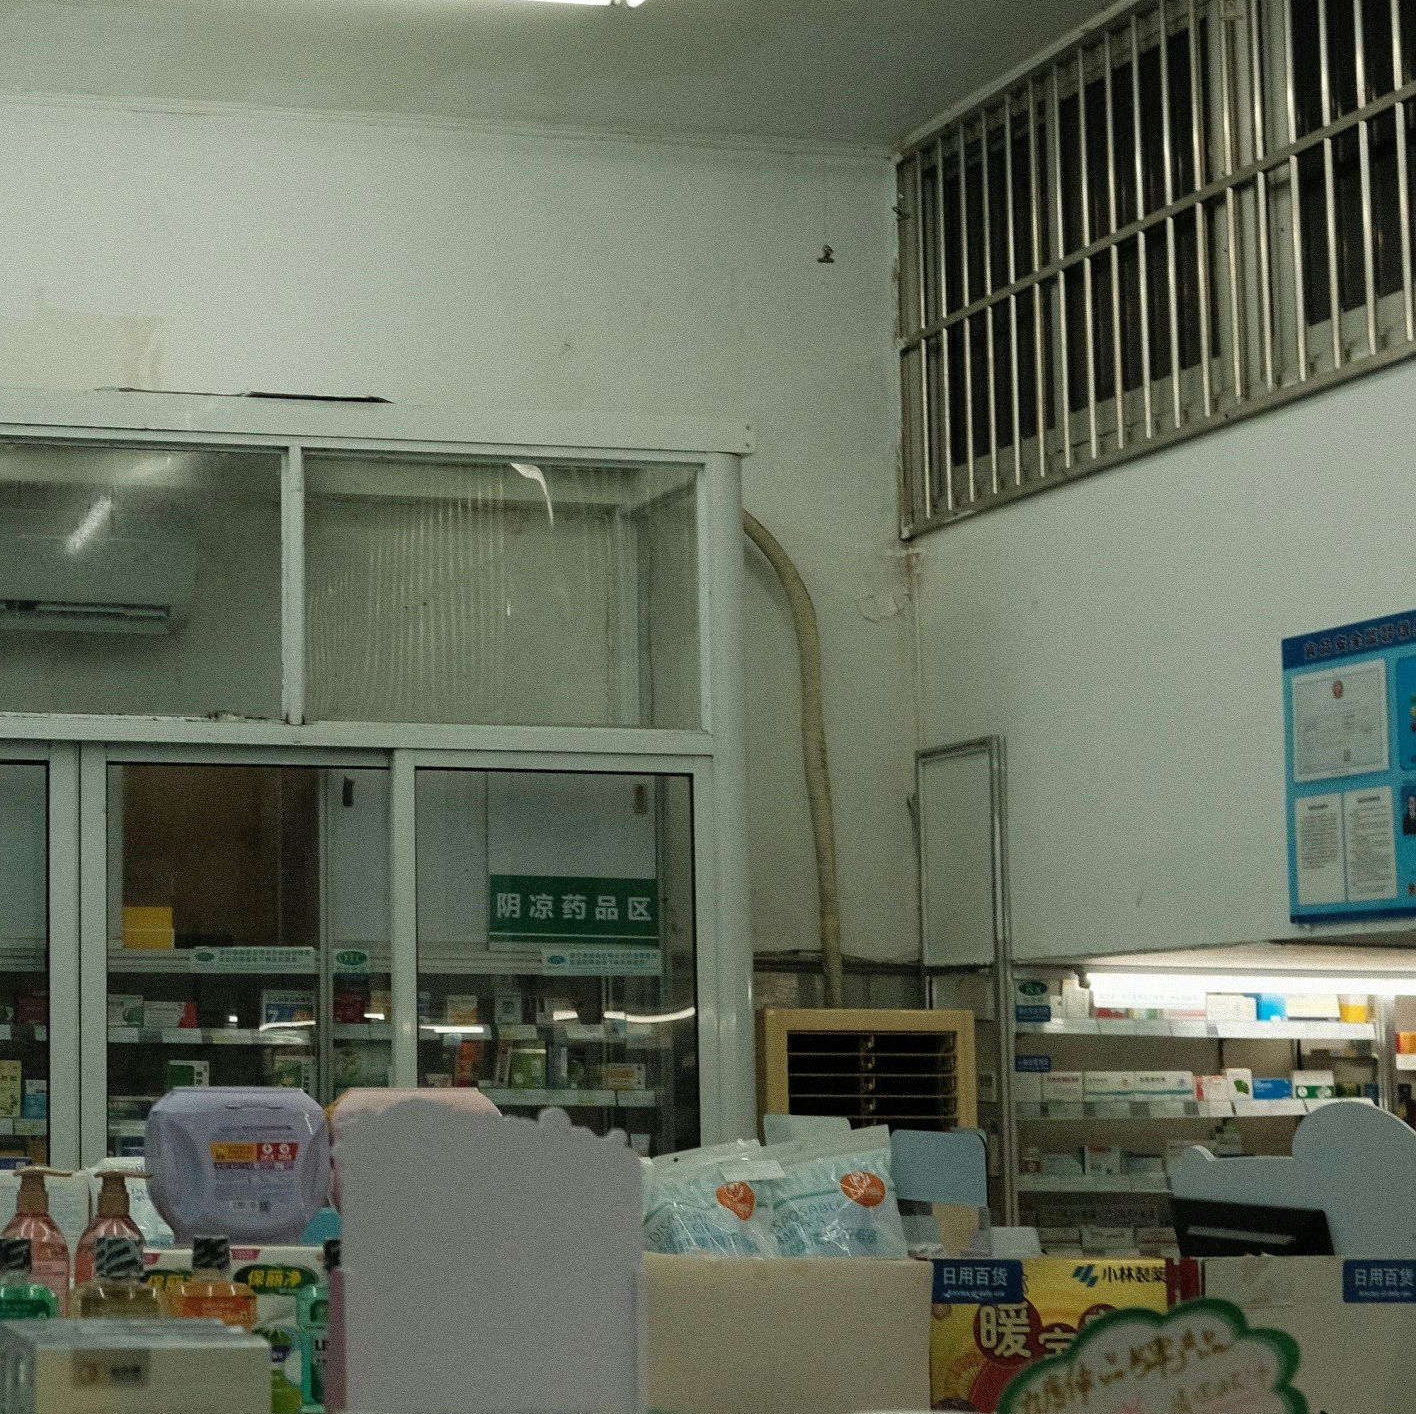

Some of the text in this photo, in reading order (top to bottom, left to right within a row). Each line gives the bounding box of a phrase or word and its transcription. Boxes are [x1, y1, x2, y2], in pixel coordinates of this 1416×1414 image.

[496, 892, 652, 922] 阴凉药品区
[247, 1268, 303, 1289] 保丽净
[942, 1266, 1009, 1287] 日用百货
[1354, 1267, 1415, 1288] 日用百货
